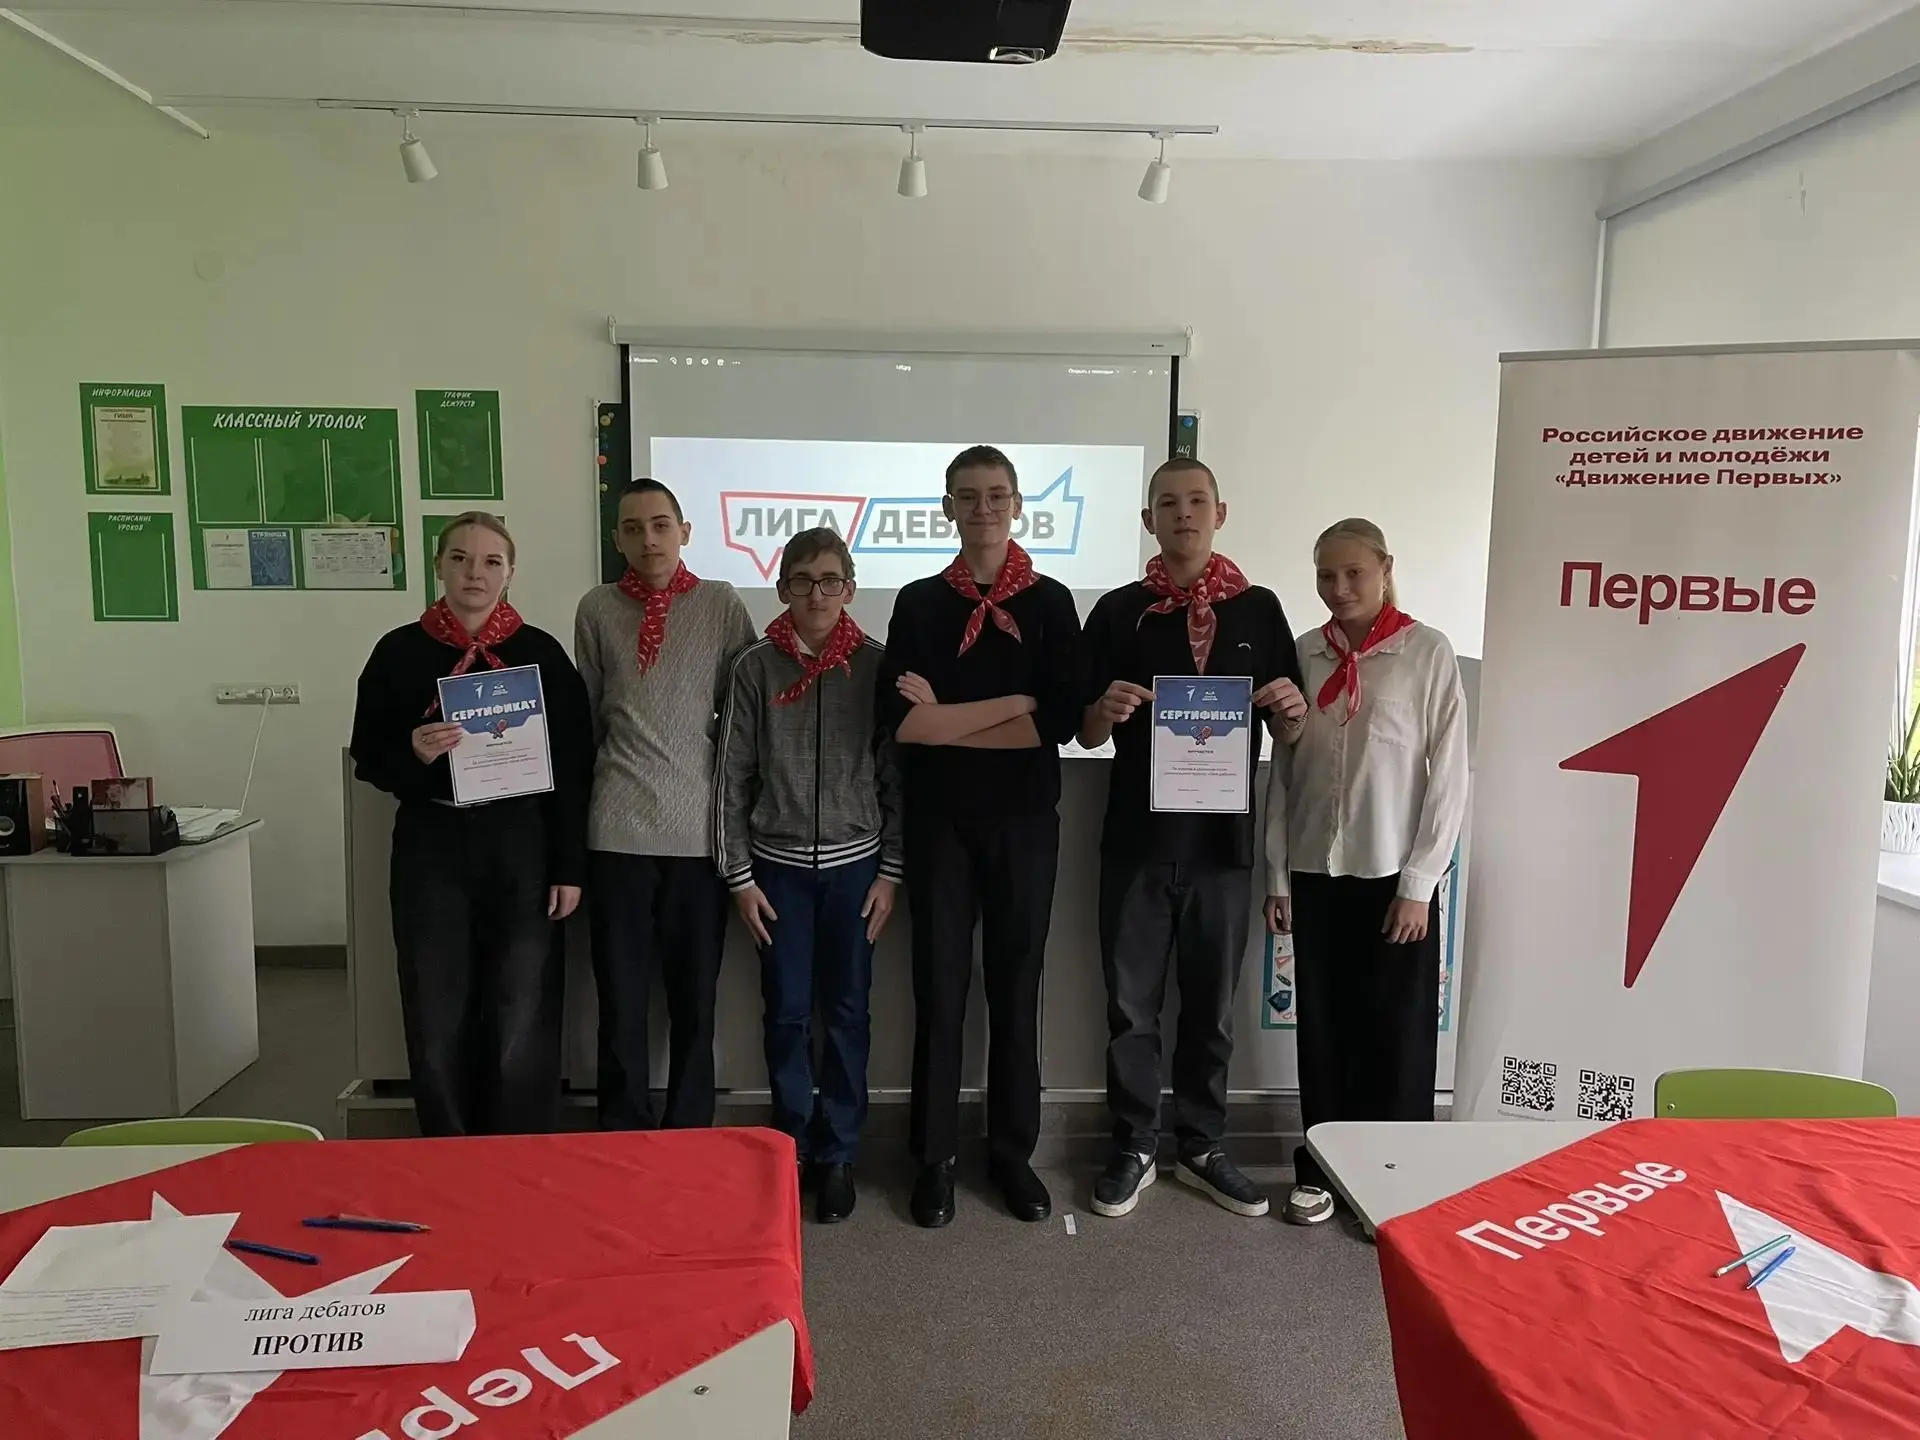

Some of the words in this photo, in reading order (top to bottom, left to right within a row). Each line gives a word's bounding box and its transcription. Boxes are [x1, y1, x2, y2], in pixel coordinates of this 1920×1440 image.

[92, 387, 153, 399] ИНФОРМАЦИЯ
[213, 410, 302, 429] КЛАССНЫЙ
[307, 413, 367, 430] УГОЛОК
[1542, 426, 1707, 443] Российское
[1712, 426, 1864, 443] движение
[1569, 447, 1649, 466] детей
[1655, 451, 1672, 463] и
[1678, 446, 1830, 465] молодёжи
[1555, 469, 1710, 487] «Движение
[1716, 469, 1842, 488] Первых»
[108, 514, 152, 522] РАСПИСАНИЕ
[872, 509, 1055, 545] ДЕБОВ
[1559, 560, 1816, 625] Первые
[451, 699, 537, 722] СЕРТИФИКАТ
[1159, 710, 1244, 721] СЕРТИФИКАТ
[1456, 1161, 1688, 1260] Первые
[244, 1305, 295, 1322] лига
[298, 1300, 386, 1322] дебатов
[251, 1331, 364, 1356] ПРОТИВ
[355, 1332, 622, 1440] Пер
